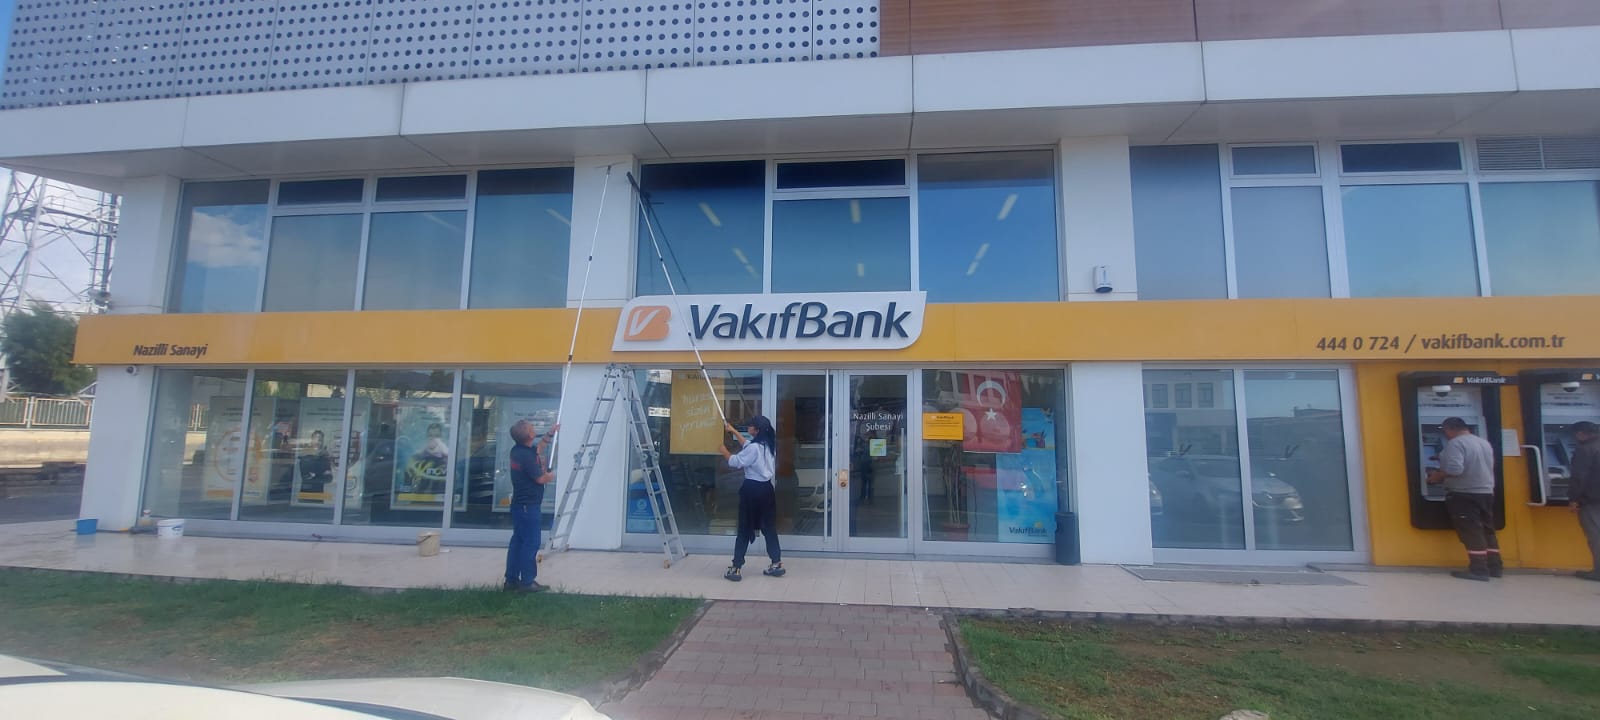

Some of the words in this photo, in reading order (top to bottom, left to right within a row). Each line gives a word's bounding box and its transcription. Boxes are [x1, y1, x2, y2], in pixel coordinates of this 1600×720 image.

[690, 301, 912, 340] VakıfBank
[1316, 337, 1347, 351] 444
[1353, 337, 1363, 350] 0
[1369, 336, 1400, 350] 724
[1421, 334, 1566, 350] vakifbank.com.tr
[133, 343, 169, 356] Nazilli
[169, 343, 209, 359] Sanayi
[853, 412, 876, 420] Nazilli
[878, 412, 904, 423] Sanayi
[866, 422, 891, 432] Şubesi
